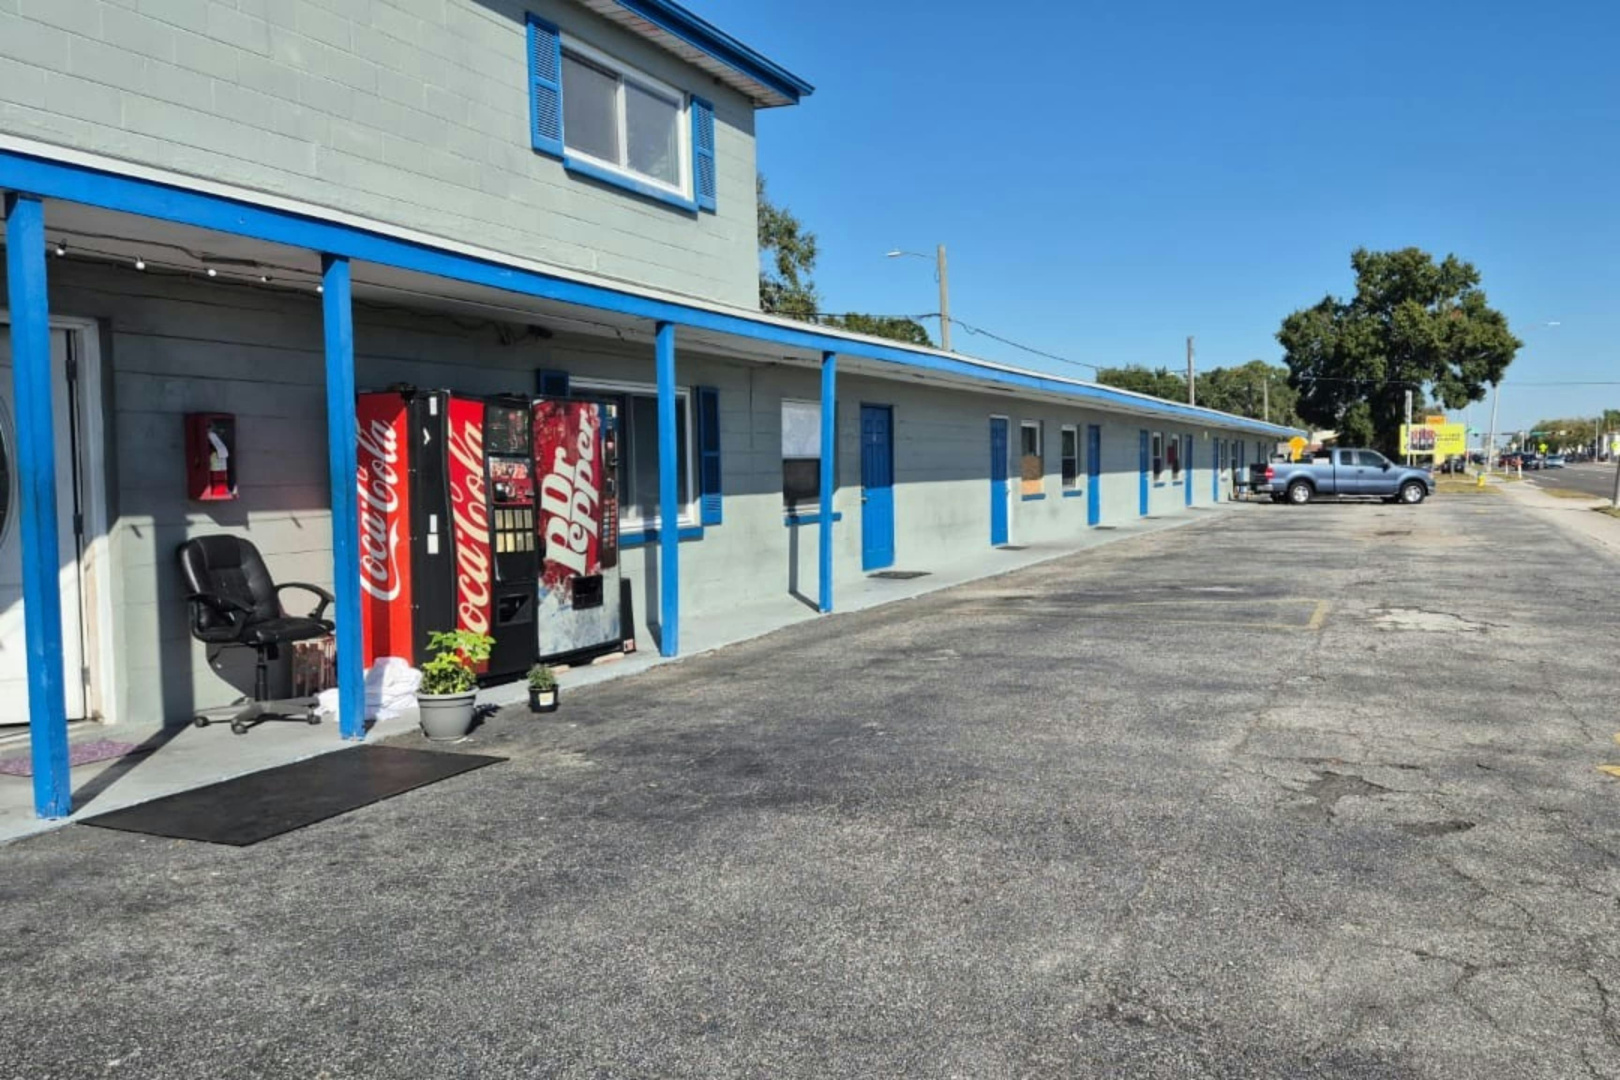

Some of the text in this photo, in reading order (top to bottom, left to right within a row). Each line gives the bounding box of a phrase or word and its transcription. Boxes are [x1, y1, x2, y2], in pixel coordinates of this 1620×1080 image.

[448, 417, 490, 636] oca-Cola
[541, 446, 575, 523] Dr
[545, 406, 599, 577] Pepper
